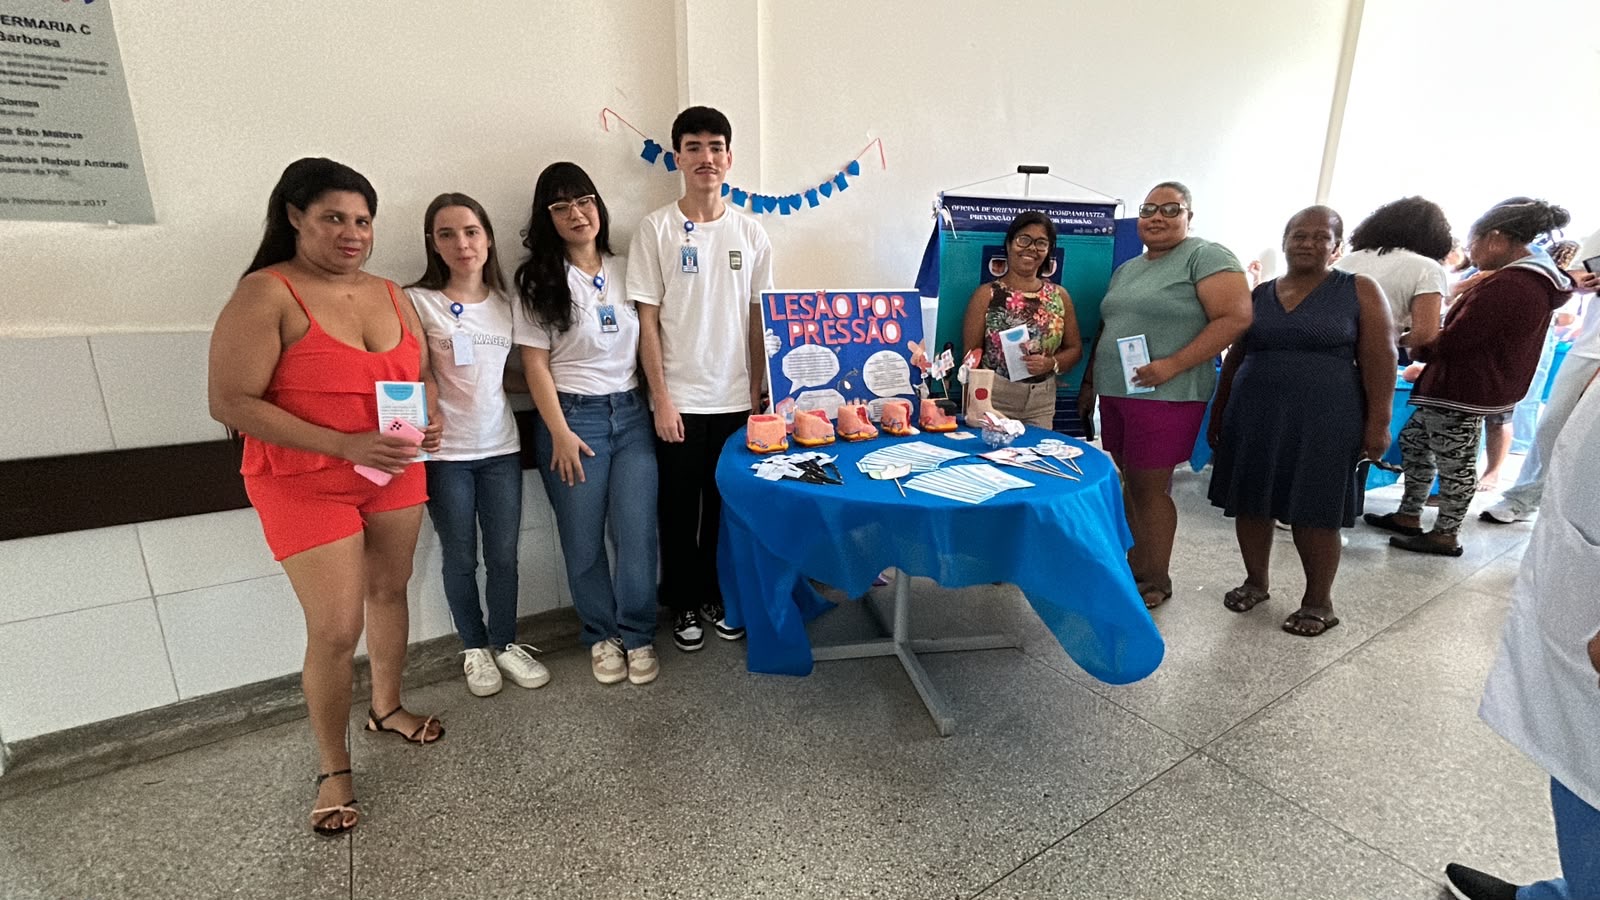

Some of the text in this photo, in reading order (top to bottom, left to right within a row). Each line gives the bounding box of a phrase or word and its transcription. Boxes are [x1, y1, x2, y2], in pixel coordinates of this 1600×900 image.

[80, 24, 91, 35] C
[0, 30, 61, 48] Barbosa
[83, 199, 107, 207] 2017
[951, 204, 980, 213] OFICINA
[969, 213, 1012, 222] PREVENÇÃO
[1060, 216, 1093, 225] PRESSÃO
[768, 290, 909, 321] LESÃO POR
[788, 316, 902, 347] PRESSÃO
